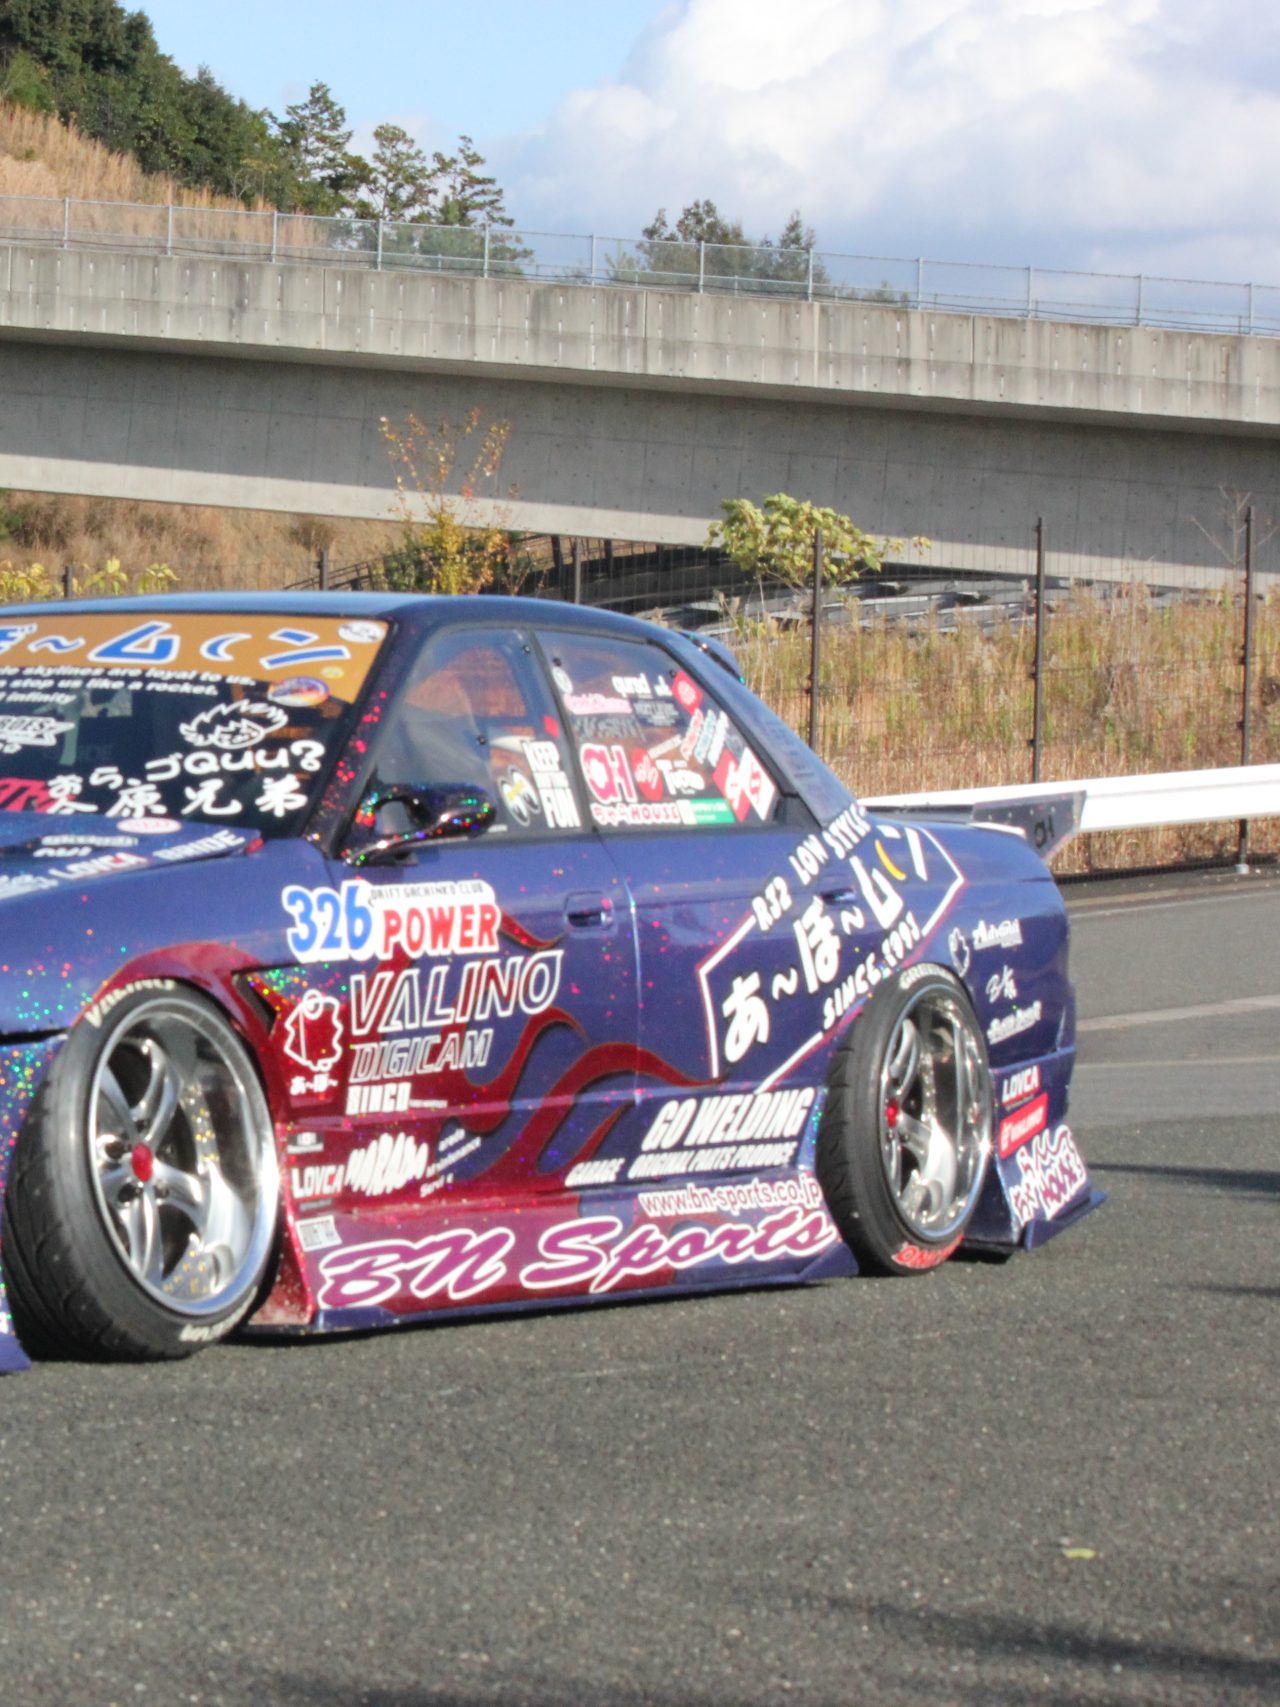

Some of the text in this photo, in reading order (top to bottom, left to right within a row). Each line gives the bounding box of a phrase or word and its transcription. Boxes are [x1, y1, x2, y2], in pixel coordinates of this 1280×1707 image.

[86, 678, 127, 690] like
[107, 668, 139, 678] are
[146, 668, 197, 681] loyal
[200, 671, 222, 683] to
[788, 834, 829, 886] LOW
[284, 882, 374, 958] 326
[382, 903, 498, 955] POWER
[350, 950, 564, 1035] VALINO
[349, 1028, 494, 1083] DIGICAM
[641, 1087, 815, 1151] GO WELDING
[638, 1172, 822, 1217] www.bn-sports.co.jp
[520, 1205, 838, 1294] Sports
